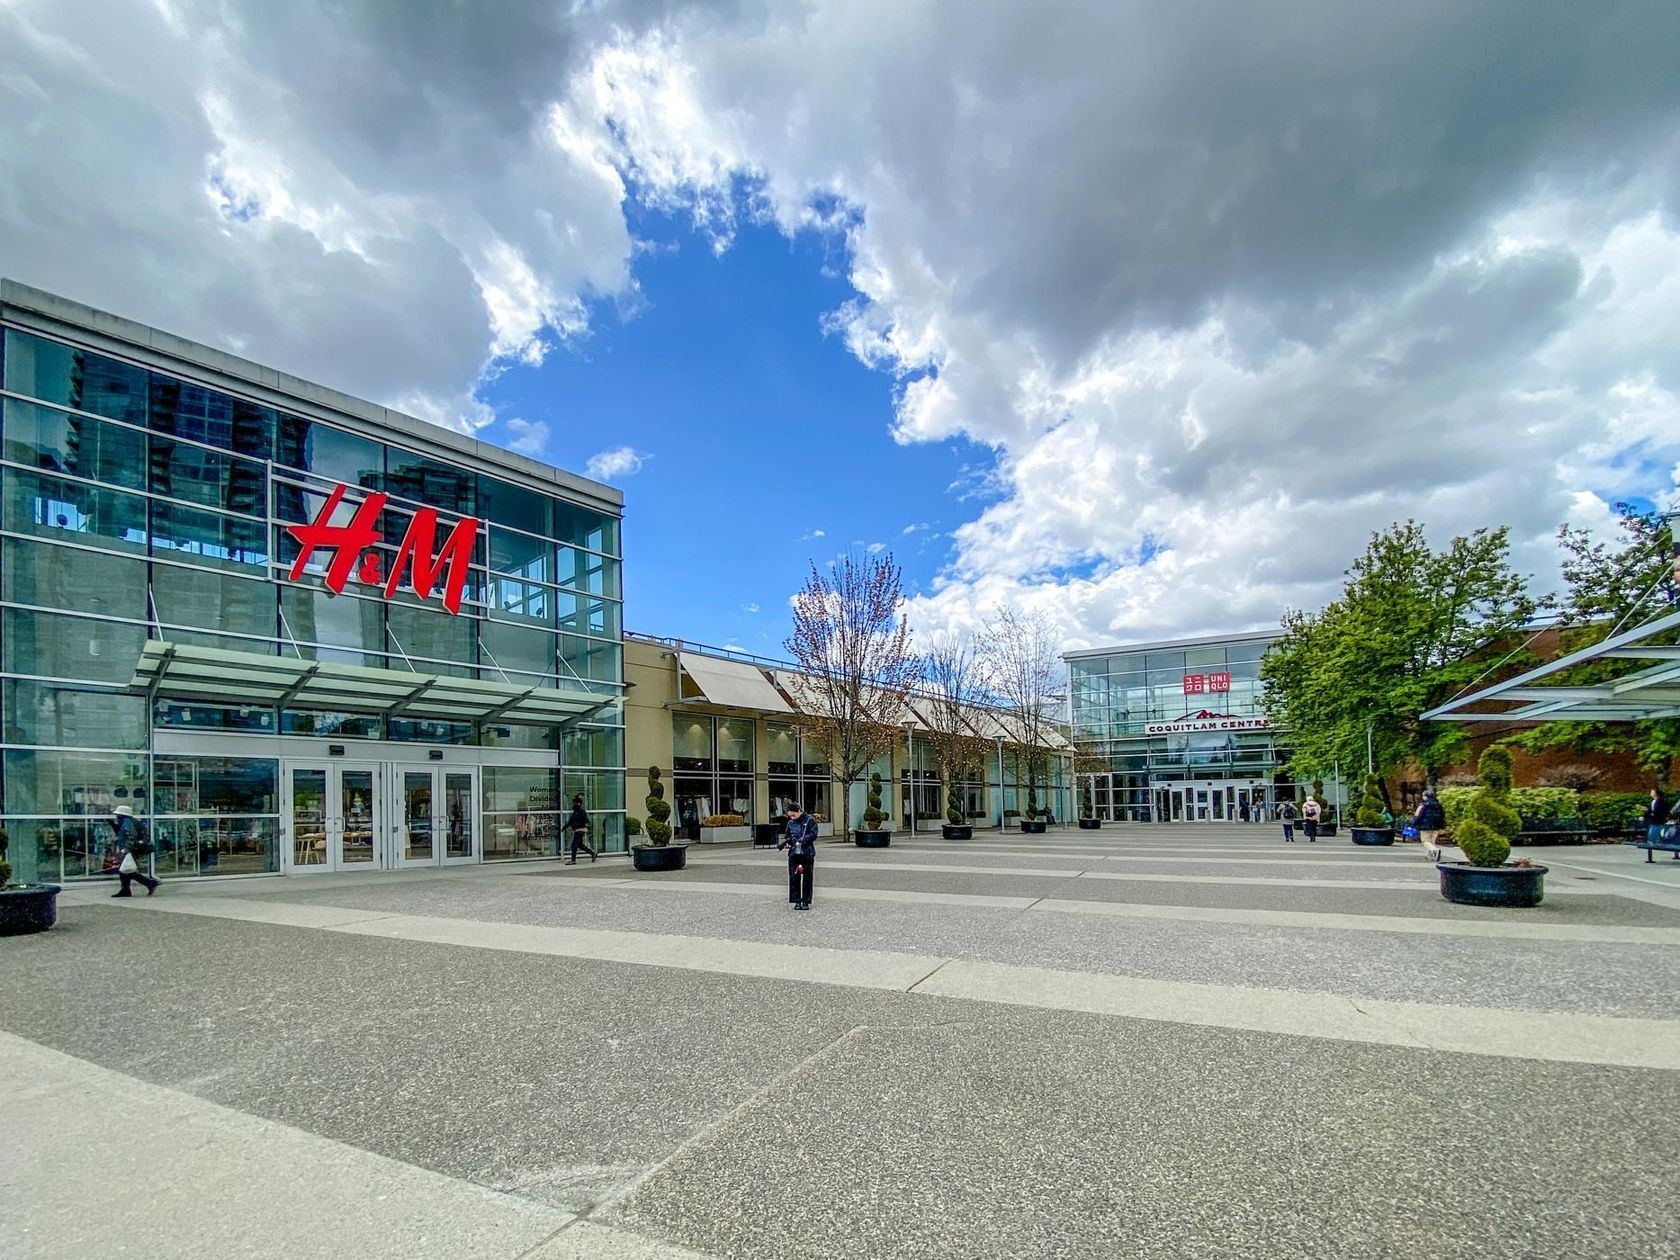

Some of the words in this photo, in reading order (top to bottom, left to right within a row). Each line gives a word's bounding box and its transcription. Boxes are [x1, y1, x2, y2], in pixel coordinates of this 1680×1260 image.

[287, 483, 478, 615] H&M
[1211, 674, 1227, 682] UNI
[1211, 682, 1228, 690] QLO
[1149, 722, 1217, 732] COQUITLAM
